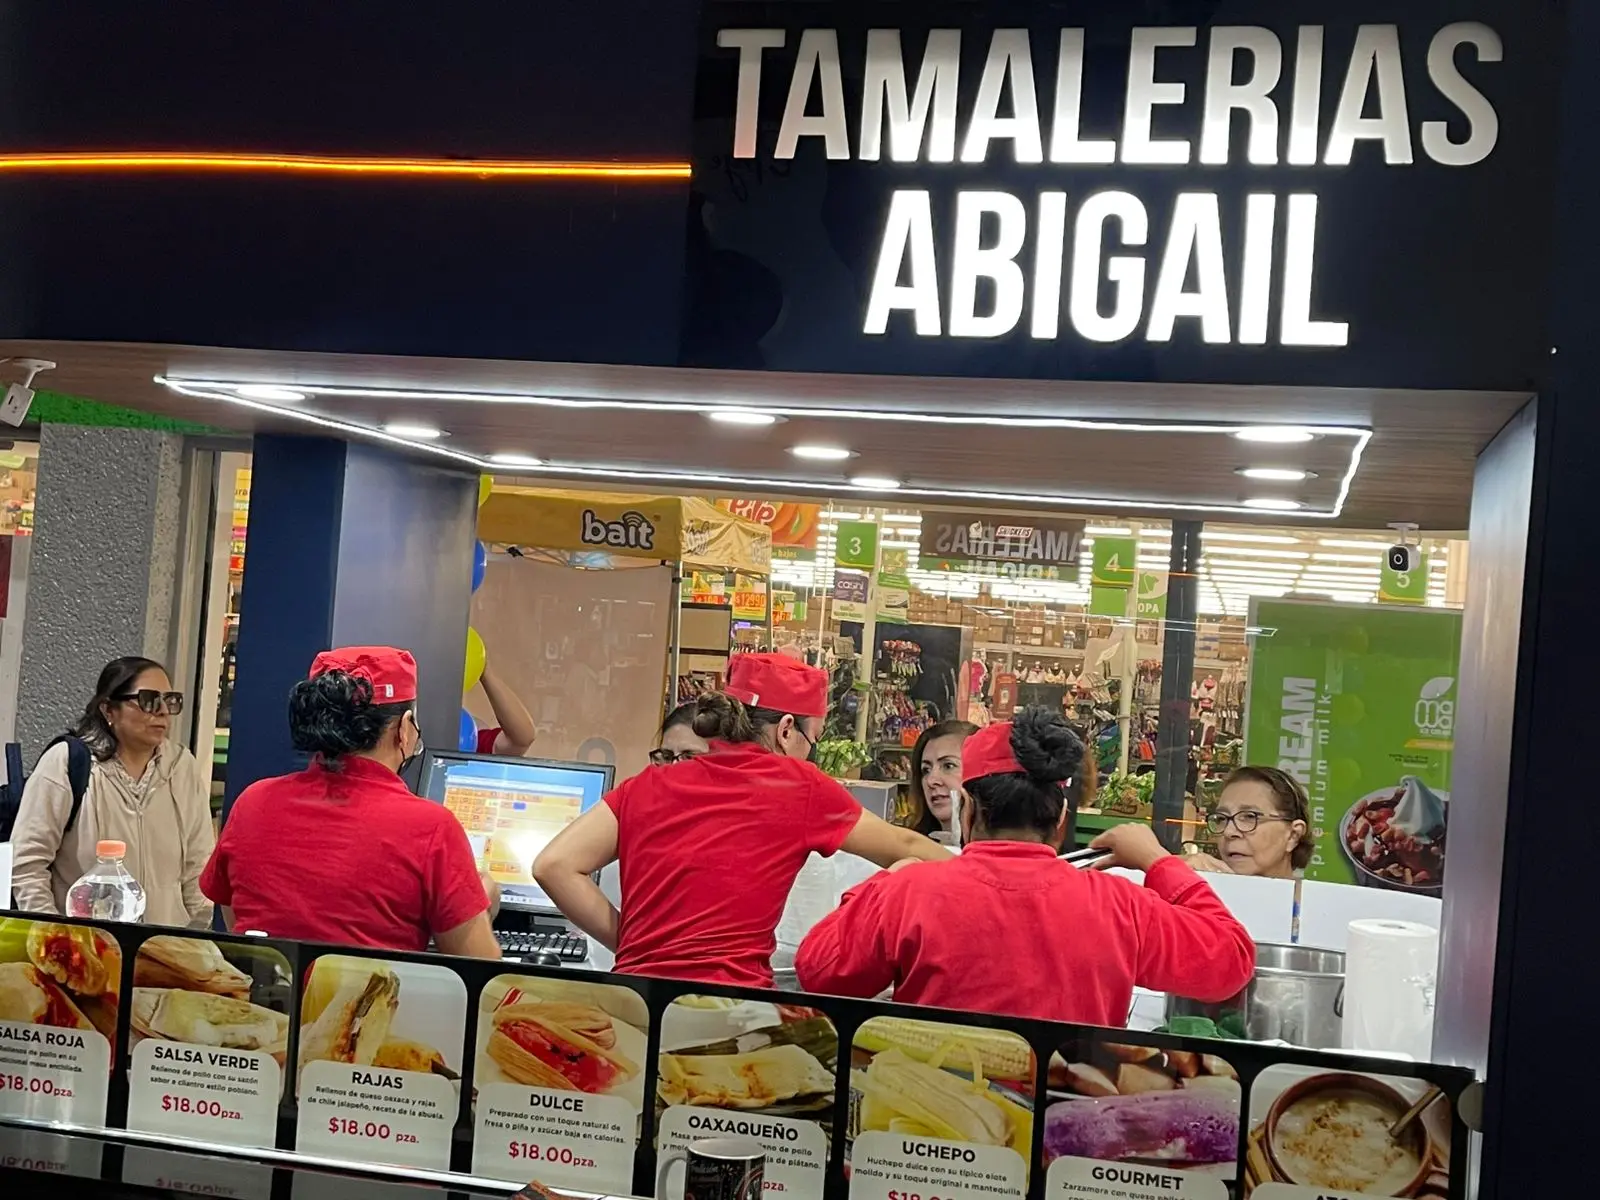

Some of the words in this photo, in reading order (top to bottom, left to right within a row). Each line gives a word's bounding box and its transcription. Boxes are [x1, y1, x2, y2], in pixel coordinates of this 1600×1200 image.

[716, 19, 1505, 168] TAMALERIAS
[861, 189, 1349, 348] ABIGAIL
[582, 509, 654, 550] bait
[849, 536, 862, 556] 3
[1104, 552, 1121, 573] 4
[1396, 572, 1411, 589] 5
[1138, 603, 1160, 613] OPA
[1277, 677, 1317, 800] REAM
[46, 1033, 84, 1049] ROJA
[155, 1046, 203, 1064] SALSA
[208, 1053, 259, 1071] VERDE
[178, 1080, 205, 1089] cilantro
[352, 1071, 403, 1089] RAJAS
[316, 1086, 347, 1096] Rellenos
[360, 1092, 382, 1101] queso
[384, 1095, 409, 1104] oaxaca
[418, 1100, 436, 1108] rajas
[530, 1093, 584, 1112] DULCE
[319, 1097, 336, 1105] chile
[337, 1100, 371, 1111] jalapeño,
[372, 1105, 396, 1113] receta
[418, 1110, 444, 1120] abuela.
[489, 1108, 528, 1120] Preparado
[558, 1117, 580, 1127] toque
[582, 1121, 610, 1130] natural
[328, 1117, 390, 1139] $18.00
[396, 1133, 420, 1144] pza.
[484, 1119, 503, 1128] fresa
[512, 1122, 528, 1131] piña
[538, 1126, 563, 1136] azúcar
[565, 1129, 580, 1138] baja
[594, 1133, 626, 1144] calorías.
[671, 1131, 690, 1140] Masa
[688, 1115, 798, 1141] OAXAQUEÑO
[779, 1145, 789, 1153] de
[791, 1147, 812, 1157] pollo
[902, 1141, 976, 1163] UCHEPO
[788, 1157, 822, 1170] plátano.
[867, 1156, 904, 1168] Huchepo
[906, 1162, 928, 1172] dulce
[930, 1165, 945, 1173] con
[986, 1173, 1007, 1182] elote
[855, 1167, 883, 1177] molido
[892, 1171, 902, 1179] su
[931, 1178, 962, 1188] original
[971, 1183, 1021, 1196] mantequilla
[1062, 1182, 1109, 1195] Zarzamora
[1111, 1189, 1127, 1197] con
[1092, 1167, 1184, 1191] GOURMET
